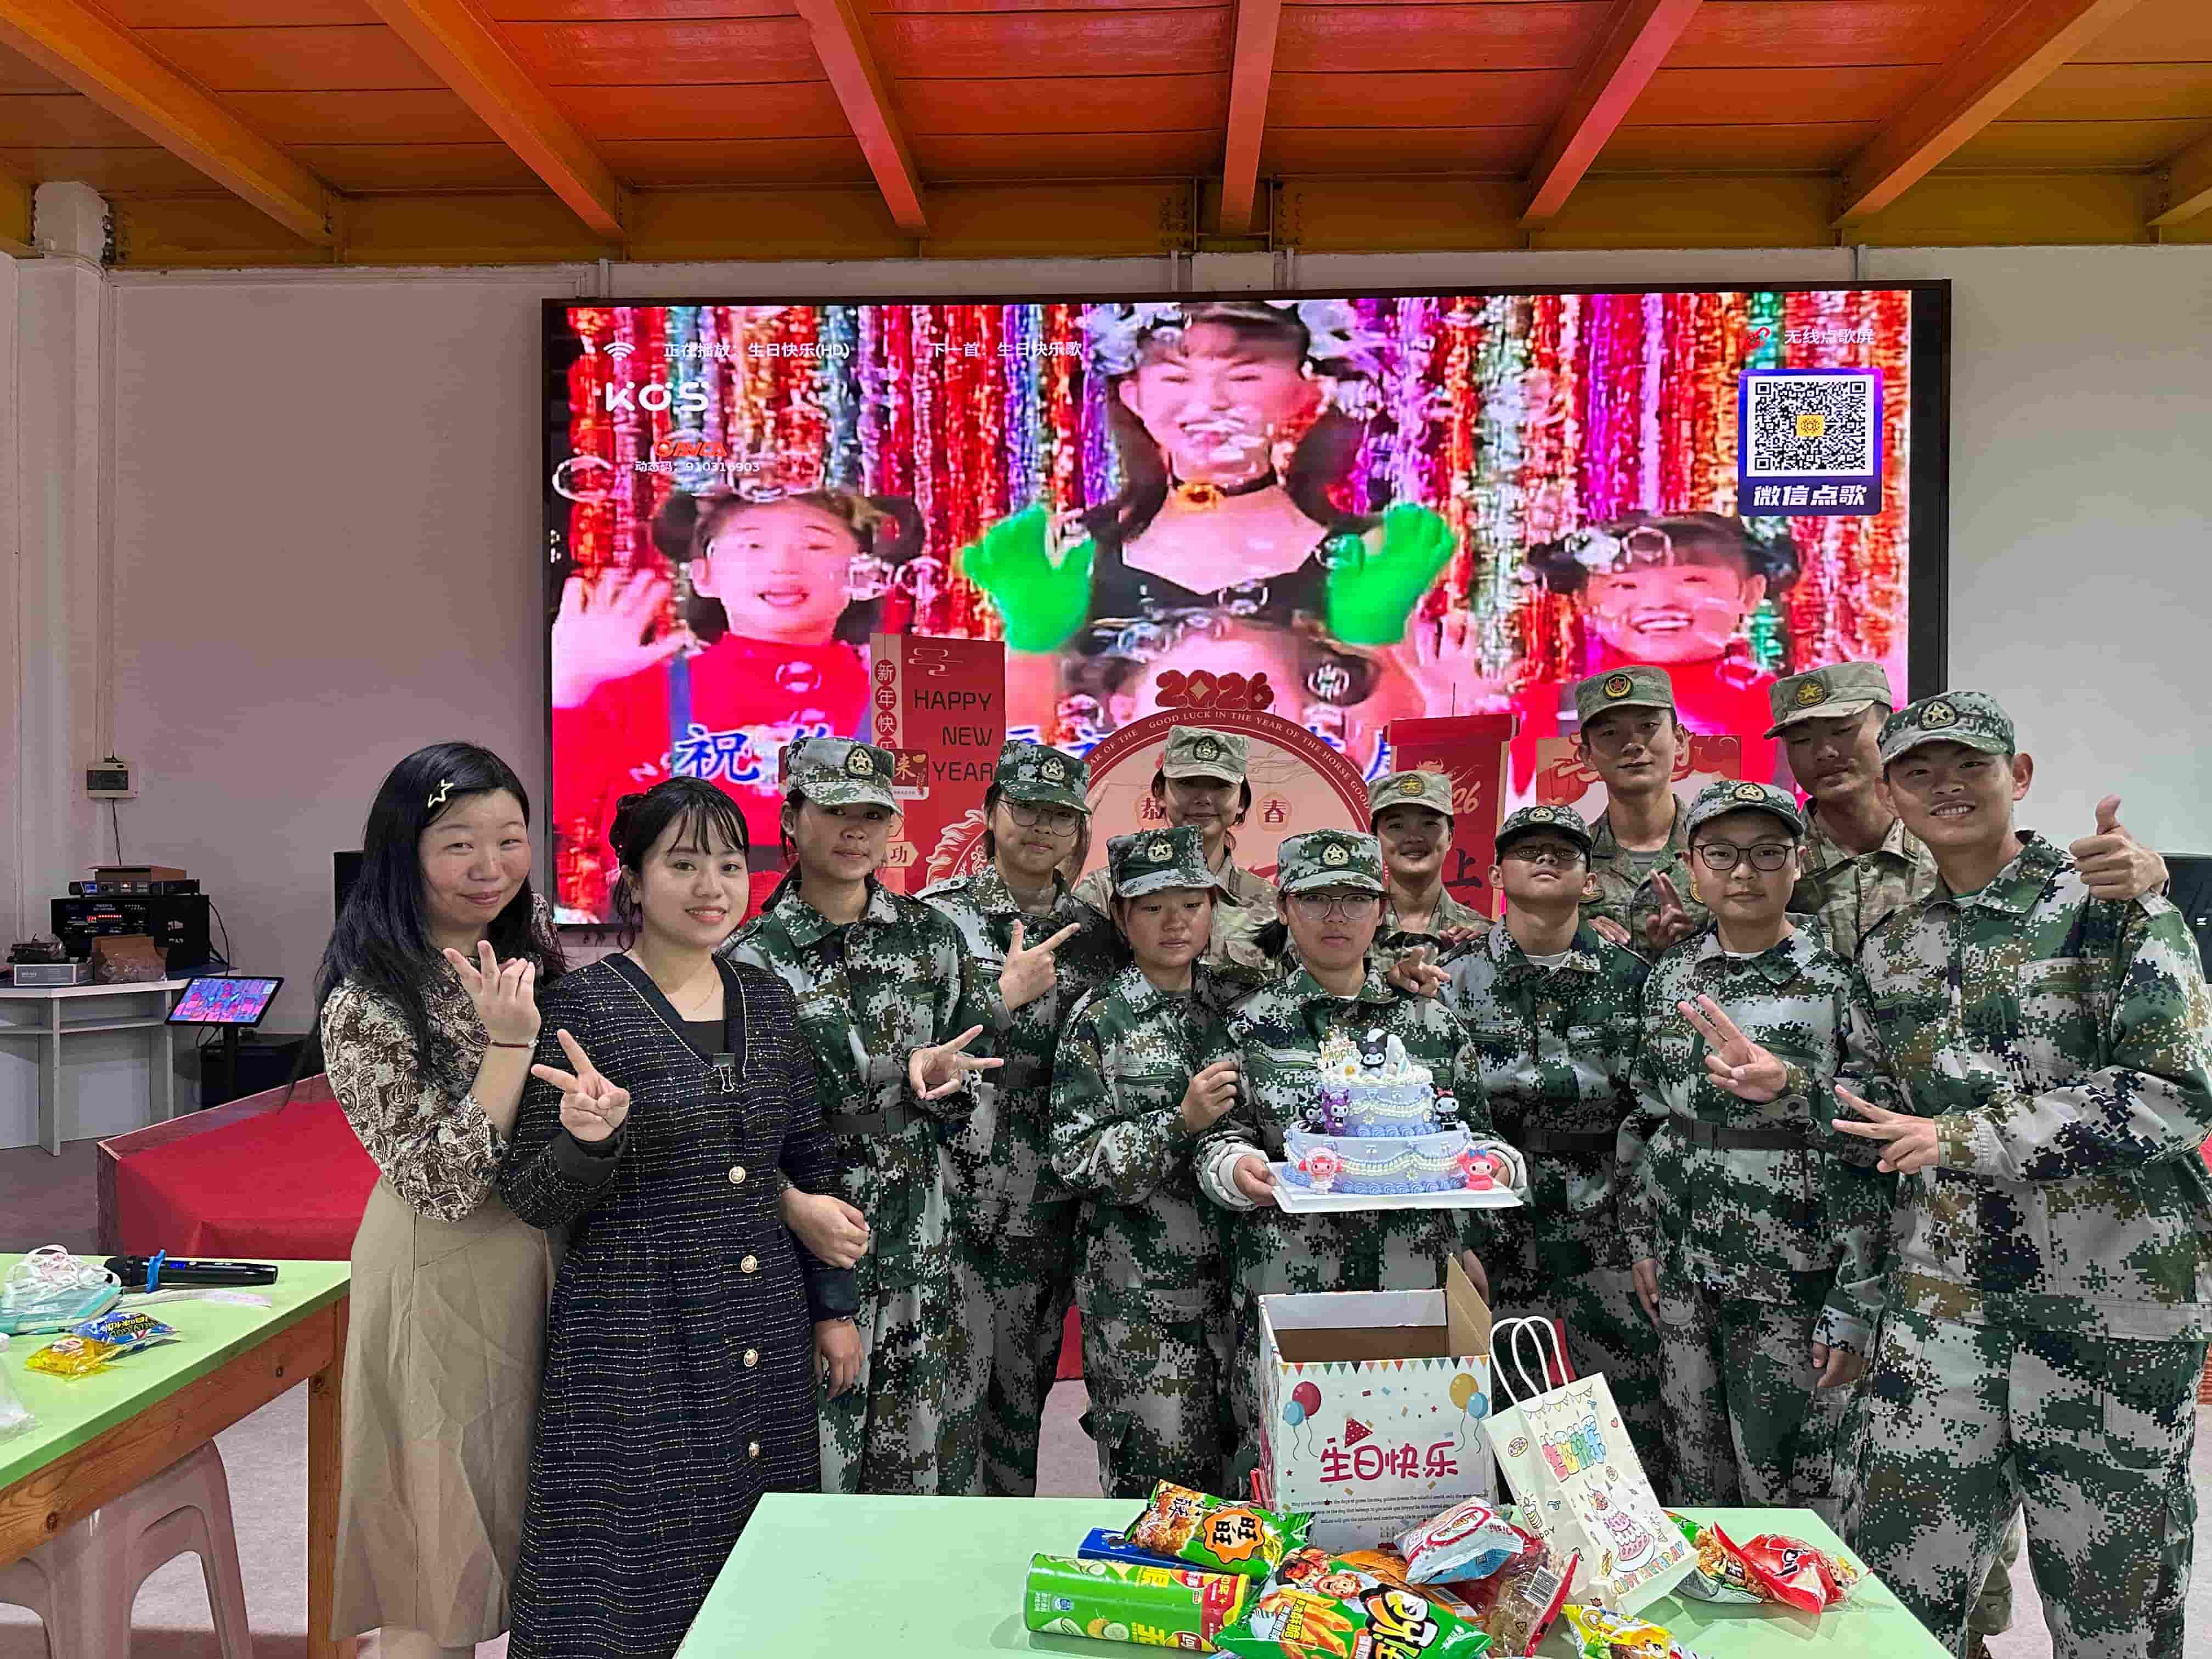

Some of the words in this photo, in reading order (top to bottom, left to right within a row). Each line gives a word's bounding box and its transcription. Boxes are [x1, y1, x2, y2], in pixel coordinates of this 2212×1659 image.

[1753, 484, 1867, 507] 微信点歌
[914, 689, 992, 712] HAPPY
[1155, 669, 1274, 711] 2026
[942, 726, 992, 747] NEW
[675, 724, 761, 782] 祝
[1089, 753, 1103, 765] AR
[1103, 742, 1116, 754] OF
[1119, 729, 1139, 743] THE
[1148, 715, 1180, 730] GOOD
[1183, 710, 1211, 720] LUCK
[1231, 712, 1252, 722] THE
[1255, 716, 1283, 731] YEAR
[1285, 728, 1300, 738] OF
[1302, 736, 1322, 753] THE
[1322, 751, 1351, 781] HORSE
[1350, 781, 1370, 809] GOOD
[932, 761, 994, 782] YEAR
[1453, 781, 1481, 815] 26
[890, 845, 908, 863] 功
[1319, 1441, 1459, 1482] 生日快乐
